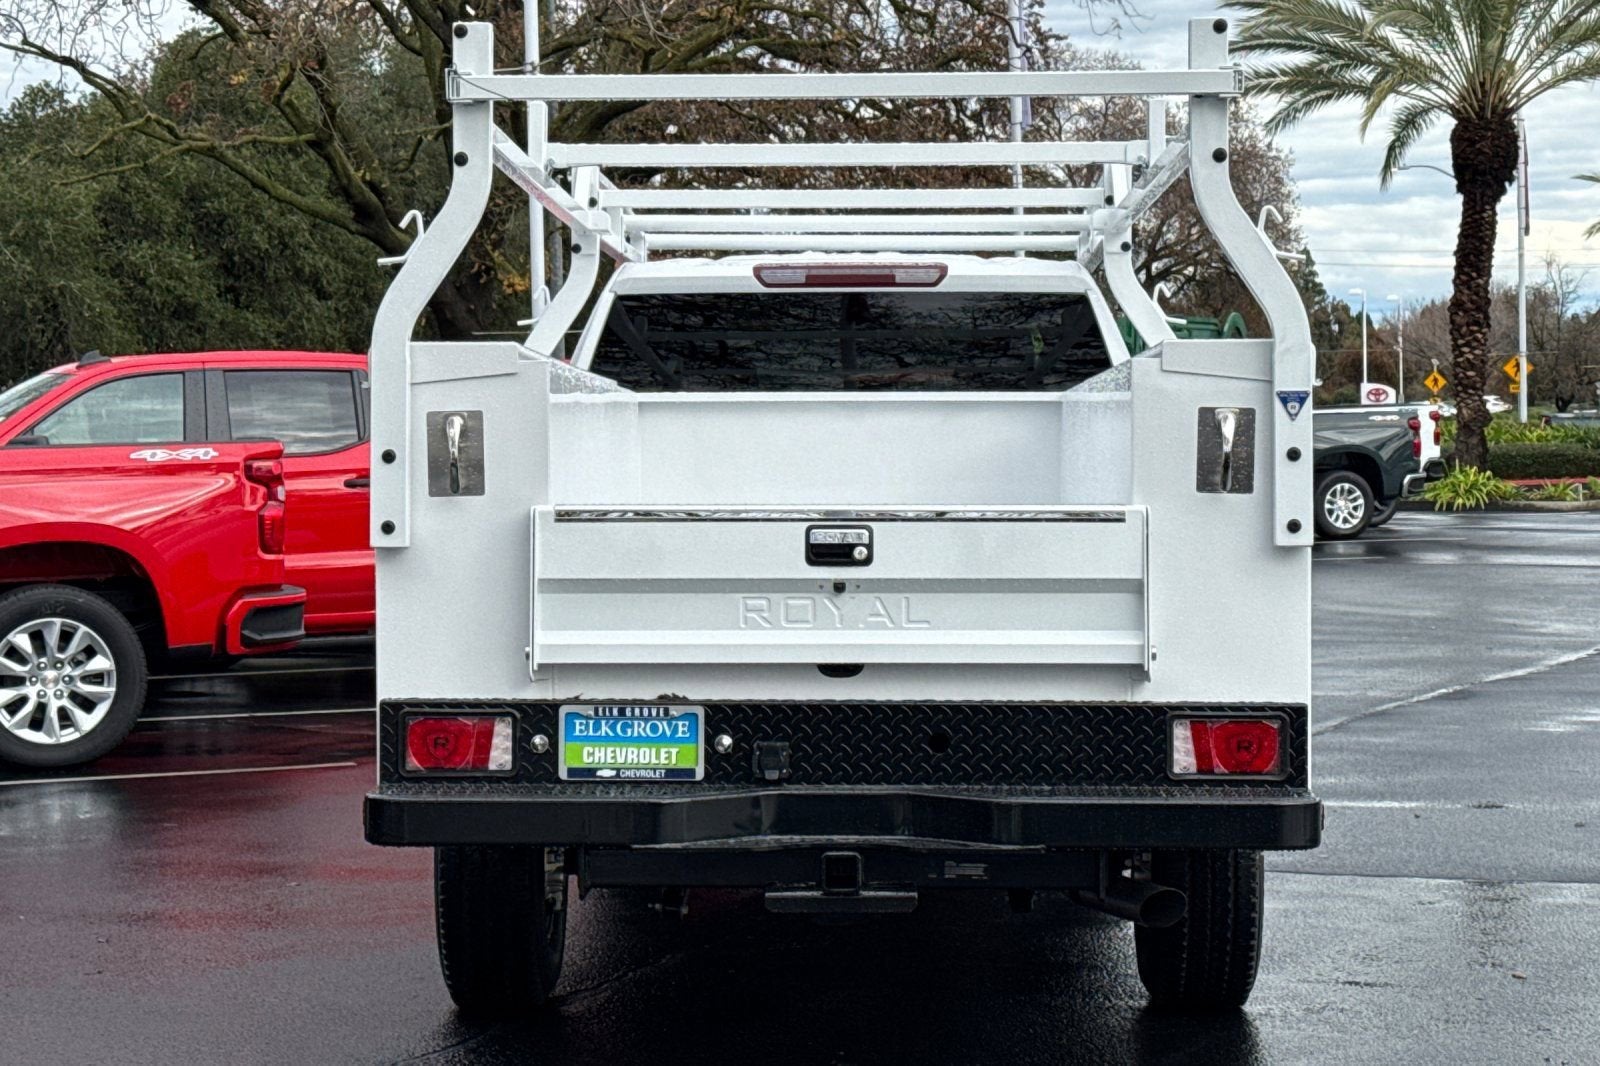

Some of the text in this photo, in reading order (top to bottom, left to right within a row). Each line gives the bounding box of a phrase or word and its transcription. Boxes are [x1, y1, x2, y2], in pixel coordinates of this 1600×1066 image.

[739, 596, 931, 628] ROYAL
[598, 707, 665, 717] ELK GROVE
[573, 719, 690, 738] ELK GROVE
[582, 746, 680, 765] CHEVROLET
[619, 769, 667, 778] CHEVROLET
